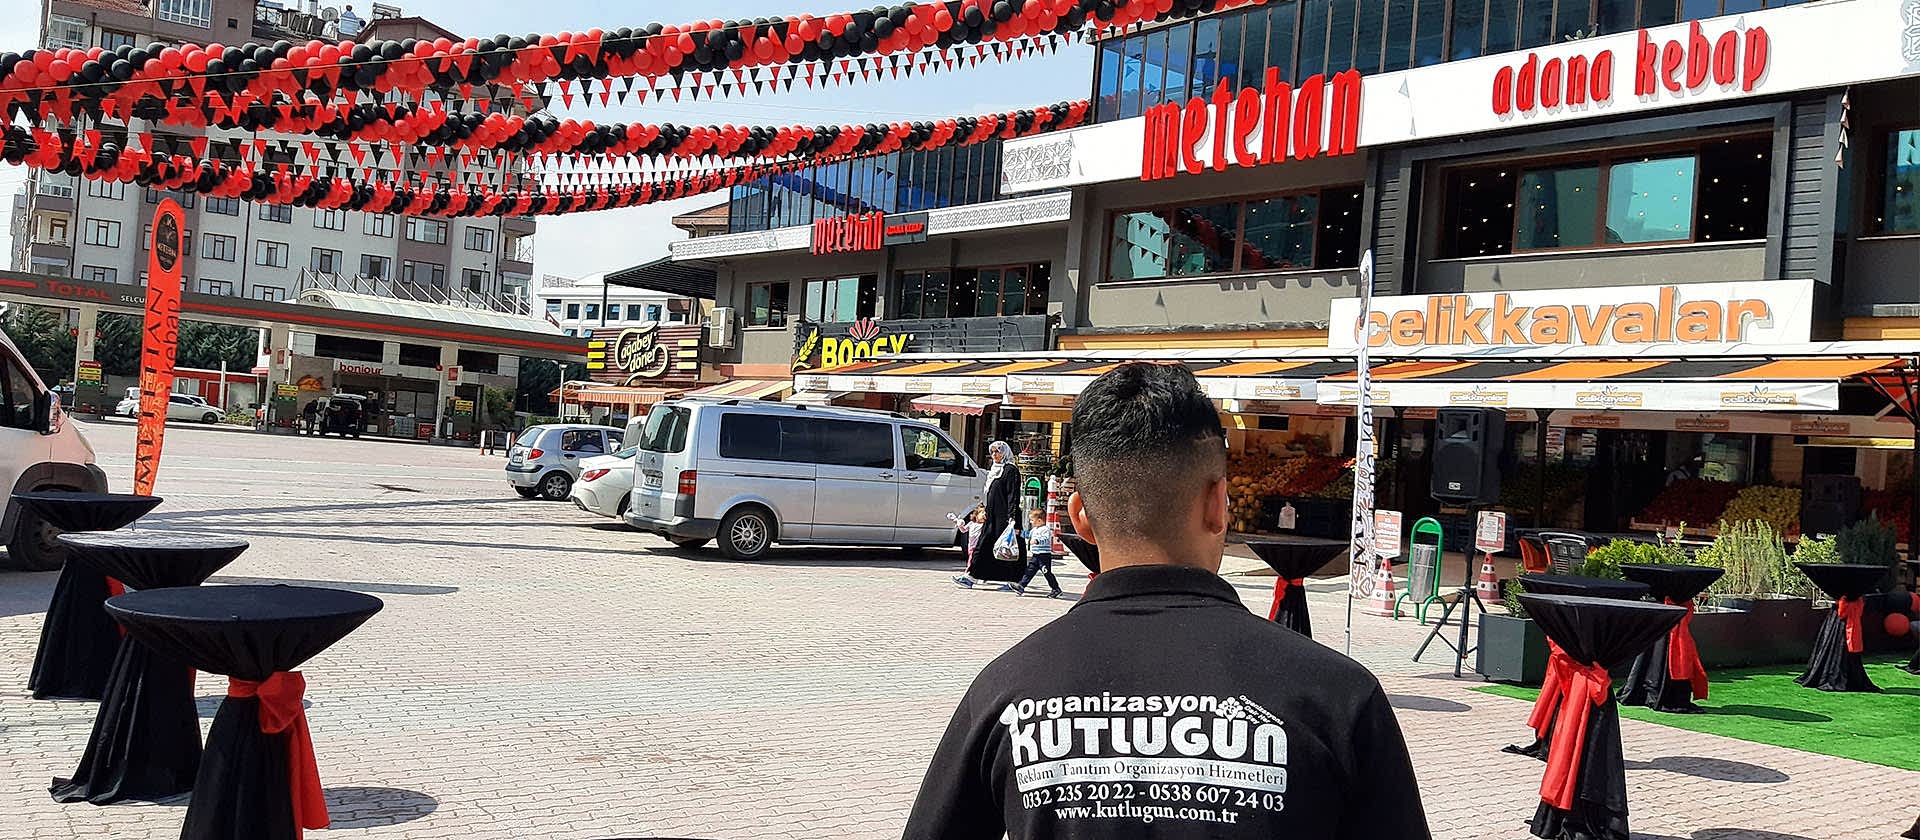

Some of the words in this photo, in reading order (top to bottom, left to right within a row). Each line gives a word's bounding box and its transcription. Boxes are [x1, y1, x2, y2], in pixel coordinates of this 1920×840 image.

[1492, 53, 1613, 115] adana
[1634, 19, 1769, 96] kebap
[1141, 66, 1362, 182] metehan
[45, 280, 112, 302] TOTAL
[1018, 767, 1054, 786] Reklam
[1060, 763, 1111, 777] Tanıtım
[1114, 761, 1205, 780] Organizasyon
[1208, 763, 1284, 785] Hizmetleri
[1022, 789, 1053, 810] 0332
[1055, 784, 1083, 802] 235
[1087, 784, 1110, 800] 20
[1112, 783, 1135, 800] 22
[1149, 783, 1192, 802] 0538
[1195, 785, 1231, 805] 607
[1234, 790, 1259, 809] 24
[1262, 793, 1285, 812] 03
[1055, 800, 1239, 824] www.kutlugun.com.tr
